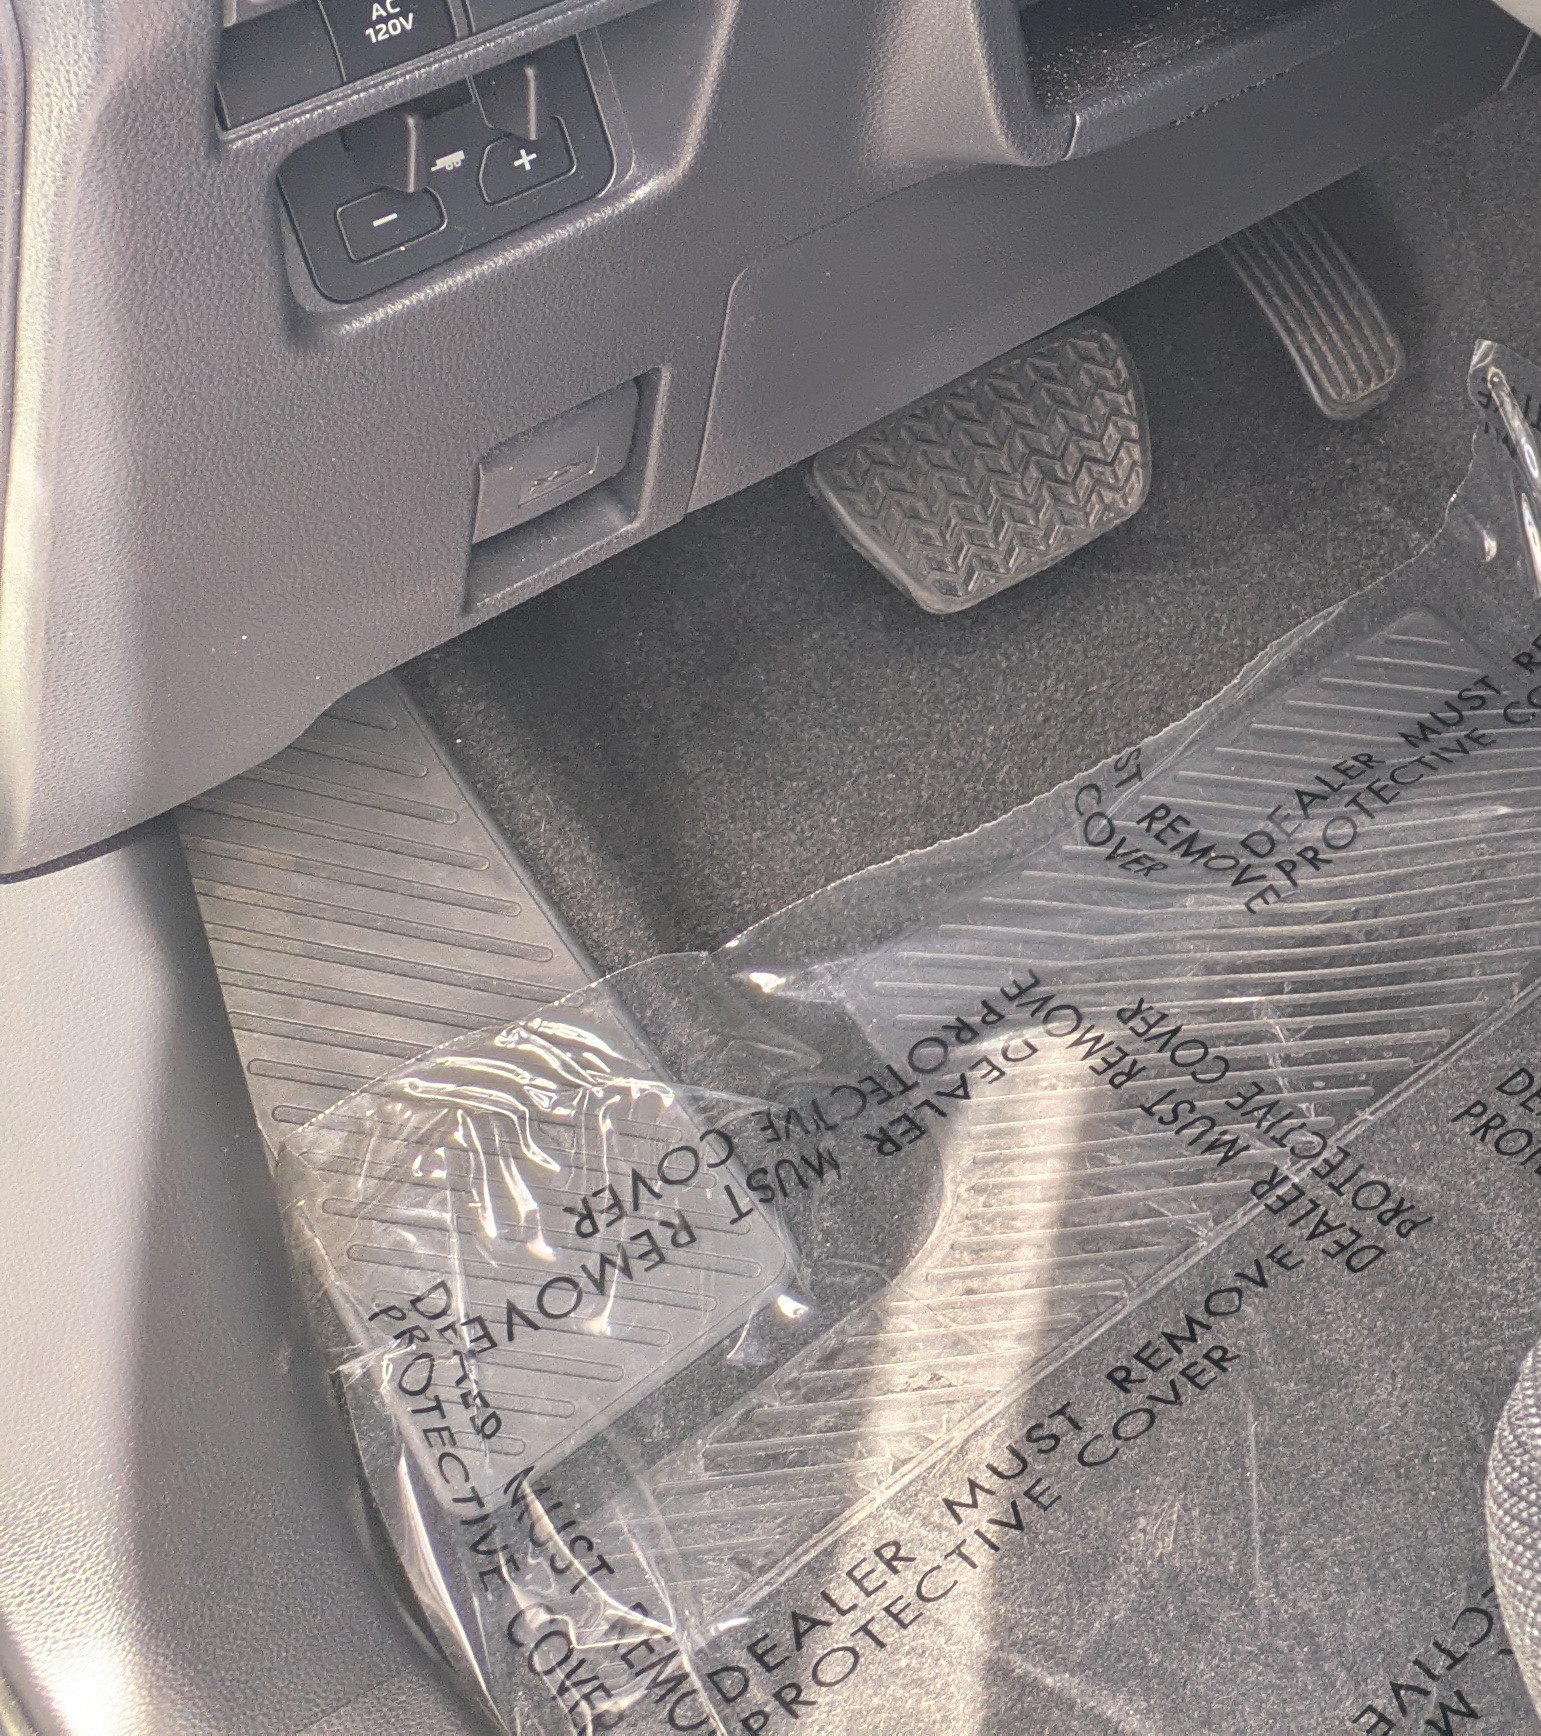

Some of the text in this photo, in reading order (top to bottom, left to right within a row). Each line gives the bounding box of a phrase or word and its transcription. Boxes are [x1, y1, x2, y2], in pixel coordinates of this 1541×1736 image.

[365, 13, 414, 44] 120V
[1072, 783, 1170, 879] COVER
[1136, 803, 1283, 916] REMOVE
[1240, 750, 1386, 861] DEALER
[1400, 673, 1508, 752] MUST
[1276, 727, 1498, 890] PROTECTIVE
[460, 1036, 1039, 1355] DEALER MUST REMOVE
[561, 999, 1006, 1239] PROTECTIVE COVER
[1000, 968, 1388, 1275] DEALER MUST REMOVE
[1116, 996, 1434, 1239] PROTECTIVE COVER
[367, 1304, 523, 1592] PROTECTIVE
[708, 1243, 1307, 1705] DEALER MUST REMOVE
[738, 1342, 1242, 1736] PROTECTIVE COVER
